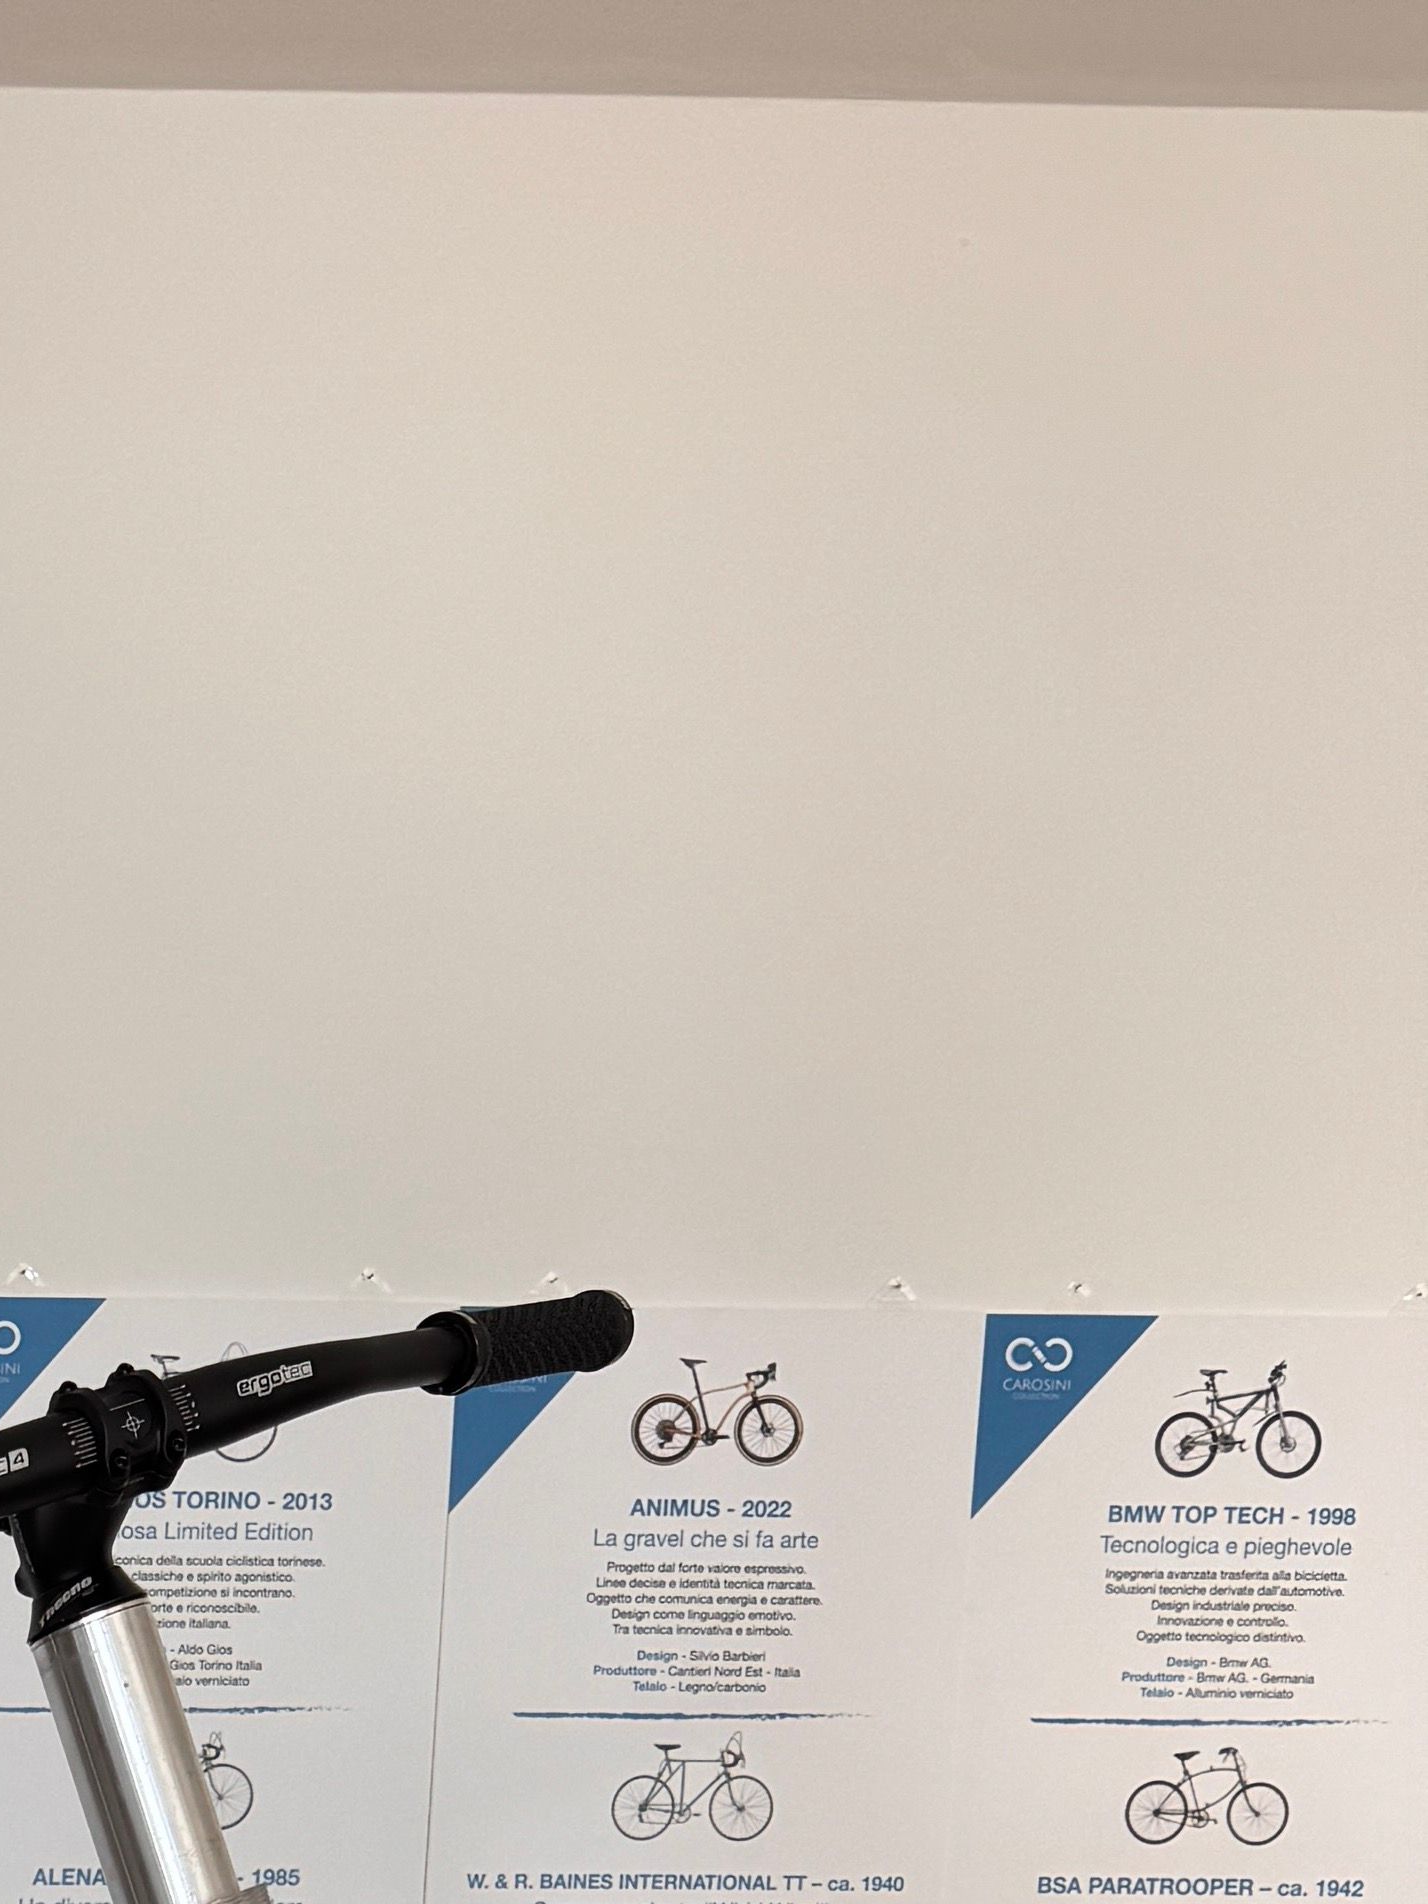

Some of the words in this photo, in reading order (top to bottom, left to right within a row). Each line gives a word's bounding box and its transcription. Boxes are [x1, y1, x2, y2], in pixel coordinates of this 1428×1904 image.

[237, 1361, 313, 1396] ergotec
[1002, 1377, 1072, 1392] CAROSINI
[8, 1447, 29, 1473] 4
[171, 1490, 261, 1510] TORINO
[282, 1492, 333, 1511] 2013
[630, 1498, 721, 1518] ANIMUS
[741, 1499, 792, 1518] 2022
[1108, 1504, 1166, 1524] BMW
[1171, 1505, 1218, 1524] TOP
[1223, 1506, 1285, 1525] TECH
[1307, 1507, 1356, 1526] 1998
[164, 1521, 239, 1541] Limited
[245, 1522, 314, 1542] Edition
[1099, 1534, 1220, 1559] Tecnologica
[1225, 1540, 1238, 1555] e
[1243, 1536, 1352, 1560] pieghevole
[1037, 1876, 1082, 1895] BSA
[1088, 1876, 1254, 1897] PARATROOPER
[1277, 1883, 1308, 1897] ca.
[1316, 1879, 1365, 1898] 1942
